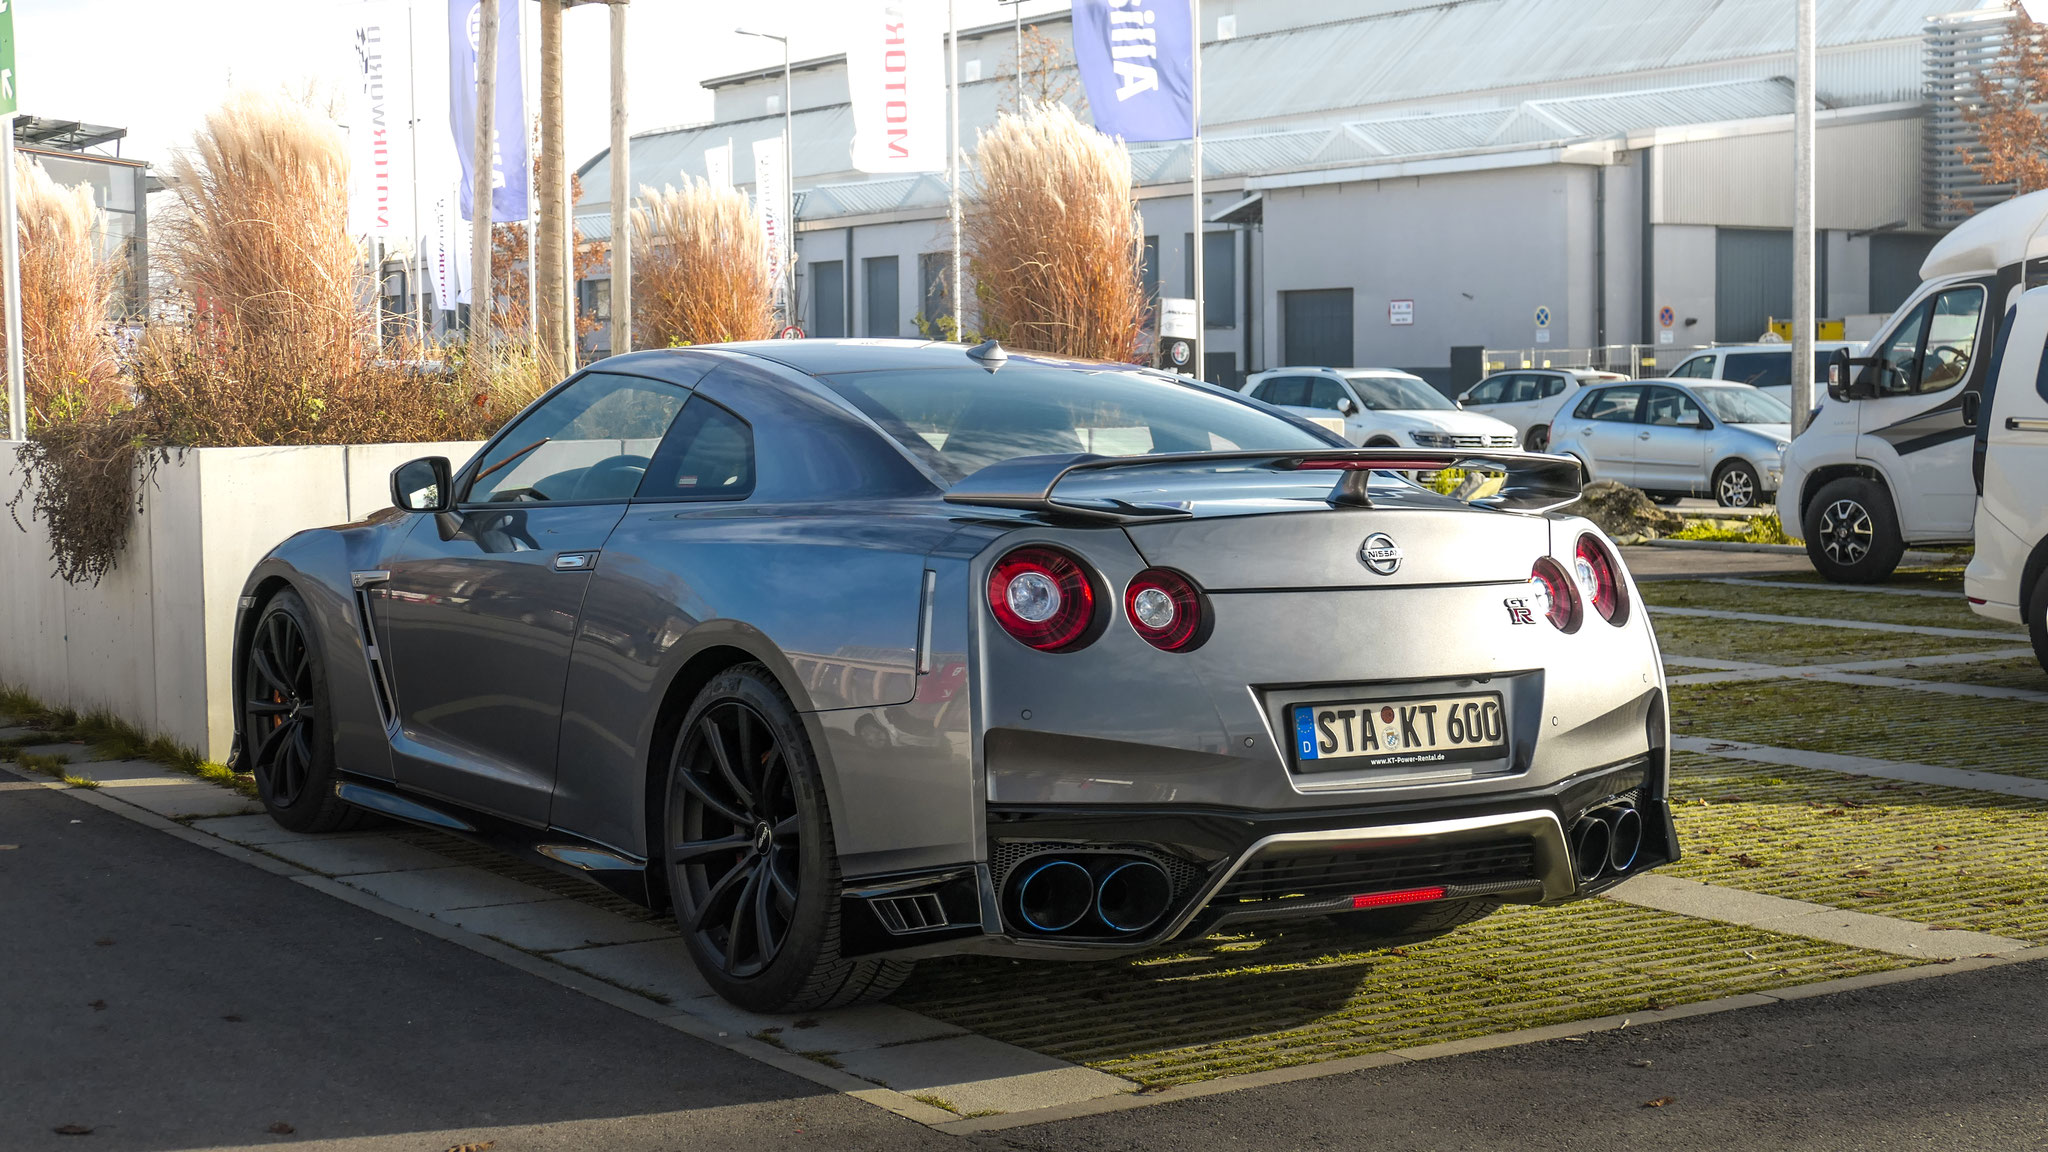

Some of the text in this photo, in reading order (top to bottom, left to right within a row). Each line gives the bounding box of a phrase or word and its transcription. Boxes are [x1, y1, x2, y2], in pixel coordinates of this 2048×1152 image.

[1318, 701, 1502, 754] STA KT 600
[1302, 740, 1312, 753] D
[1370, 753, 1445, 765] www.KT-Power-Rental.de
